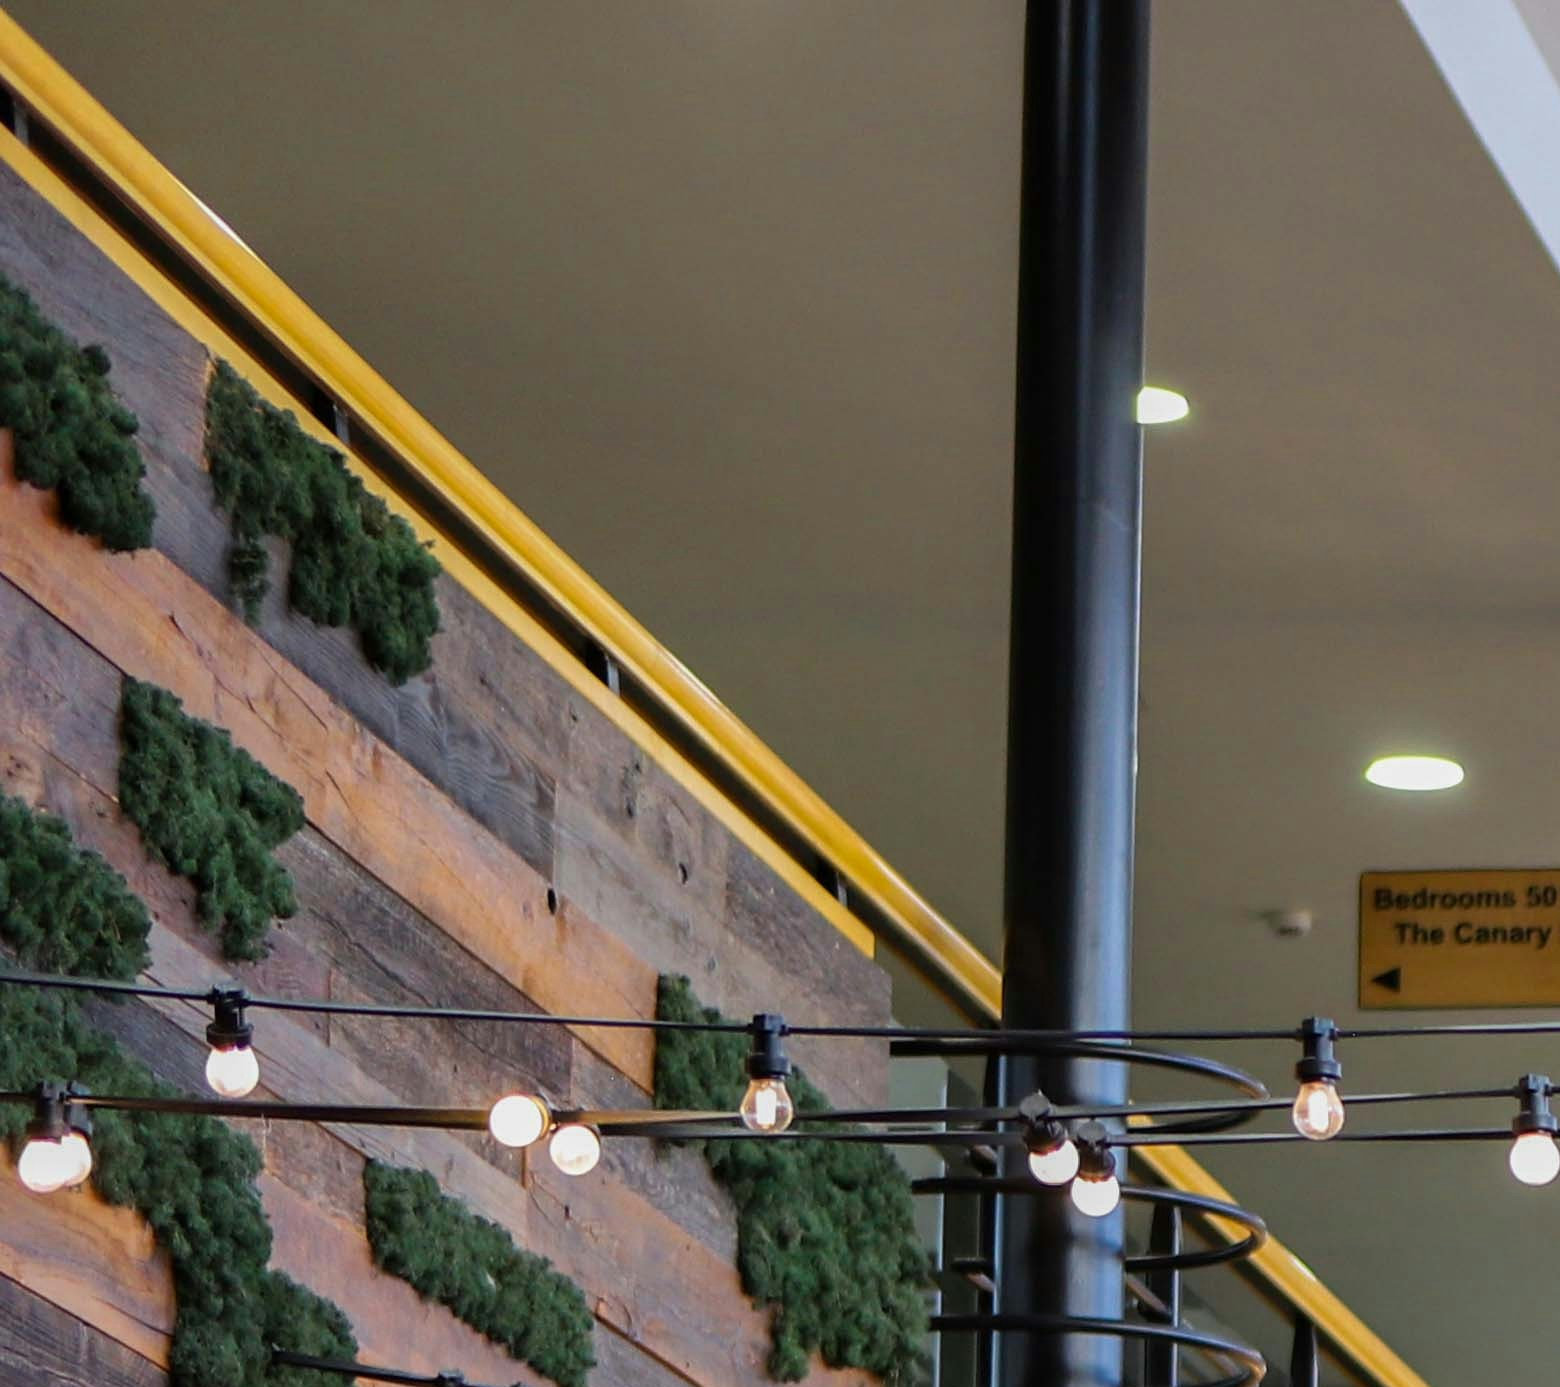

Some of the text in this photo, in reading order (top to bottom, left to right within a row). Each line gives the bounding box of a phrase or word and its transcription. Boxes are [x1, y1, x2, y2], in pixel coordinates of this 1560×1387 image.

[1374, 886, 1516, 911] Bedrooms
[1395, 923, 1444, 946] The
[1454, 922, 1552, 949] Canary
